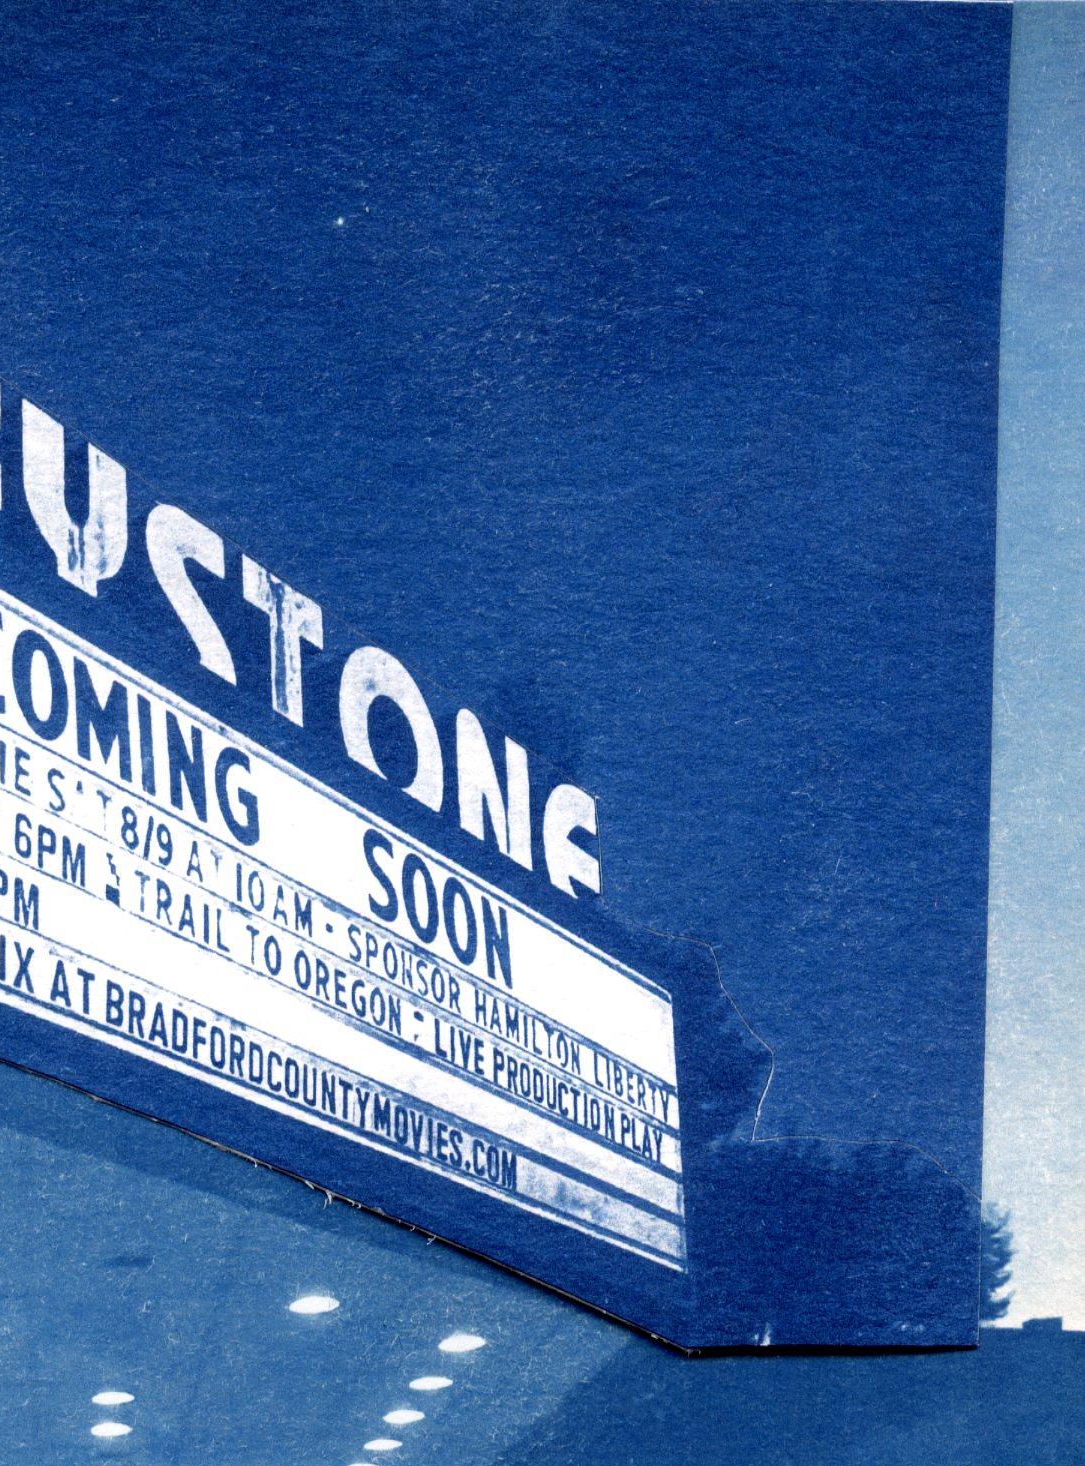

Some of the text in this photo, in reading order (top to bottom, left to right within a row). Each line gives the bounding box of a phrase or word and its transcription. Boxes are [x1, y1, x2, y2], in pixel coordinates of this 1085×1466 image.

[14, 813, 86, 887] 6PM
[134, 869, 230, 952] TRAIL
[246, 924, 282, 976] TO
[294, 950, 402, 1036] OREGON
[434, 1018, 485, 1075] LIVE
[494, 1049, 614, 1145] PRODUCTION
[621, 1114, 663, 1160] PLAY
[120, 806, 174, 866] 8/9
[236, 862, 313, 938] 10AM
[348, 924, 460, 1013] SPONSOR
[594, 1051, 671, 1122] LIBERTY
[363, 829, 513, 989] SOON
[50, 959, 96, 1014] AT
[106, 979, 517, 1190] BRADFORDCOUNTYMOVIES.COM
